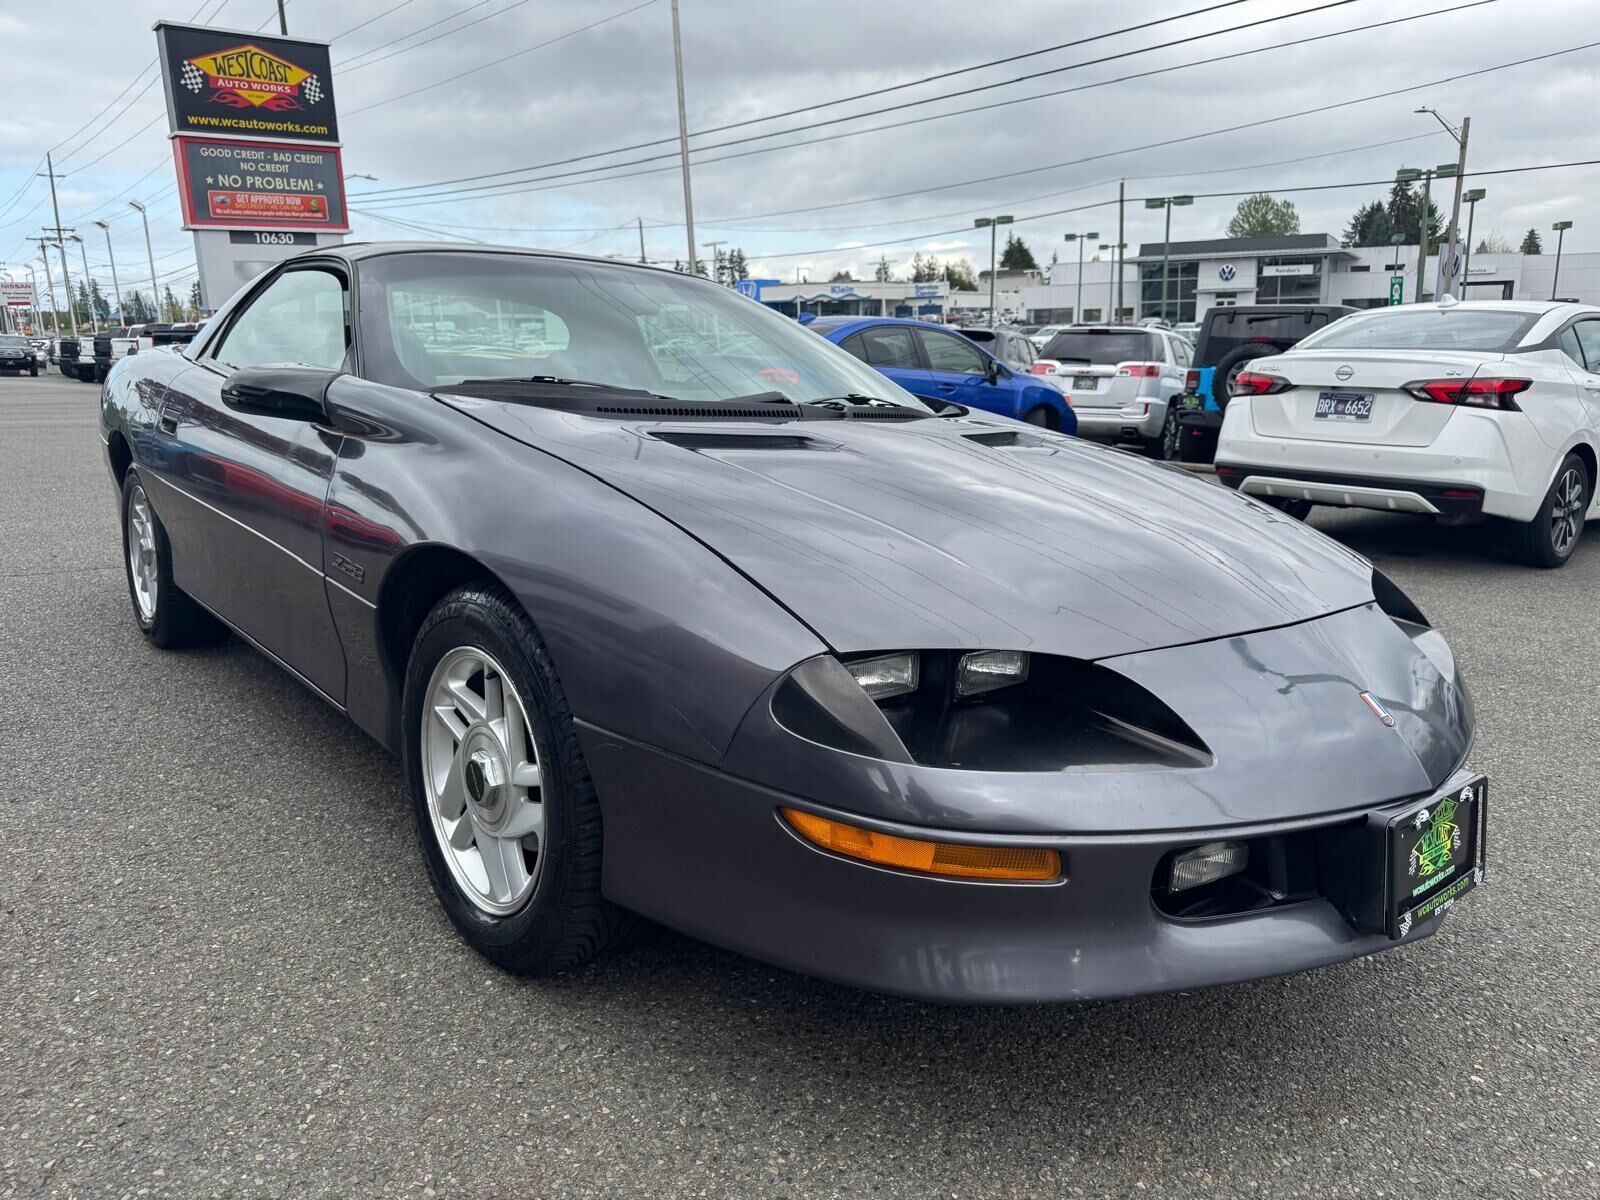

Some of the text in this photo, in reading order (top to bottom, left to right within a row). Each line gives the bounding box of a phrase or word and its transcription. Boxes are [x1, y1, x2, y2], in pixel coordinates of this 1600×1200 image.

[217, 79, 291, 94] AUTO WORKS
[187, 115, 328, 135] www.wcautoworks.com
[200, 147, 232, 157] GOOD
[234, 150, 265, 160] CREDIT
[273, 152, 292, 162] BAD
[294, 154, 323, 164] CREDIT
[240, 162, 289, 173] NO CREDIT
[218, 174, 314, 191] NO PROBLEM!
[236, 194, 301, 206] GET APPROVED NOW
[253, 232, 294, 245] 10630
[831, 285, 854, 293] Klein
[1316, 398, 1371, 415] BRX 6652
[1412, 865, 1455, 897] wcautoworks.com
[1416, 877, 1469, 918] wcautoworks.com
[1434, 903, 1443, 916] EST
